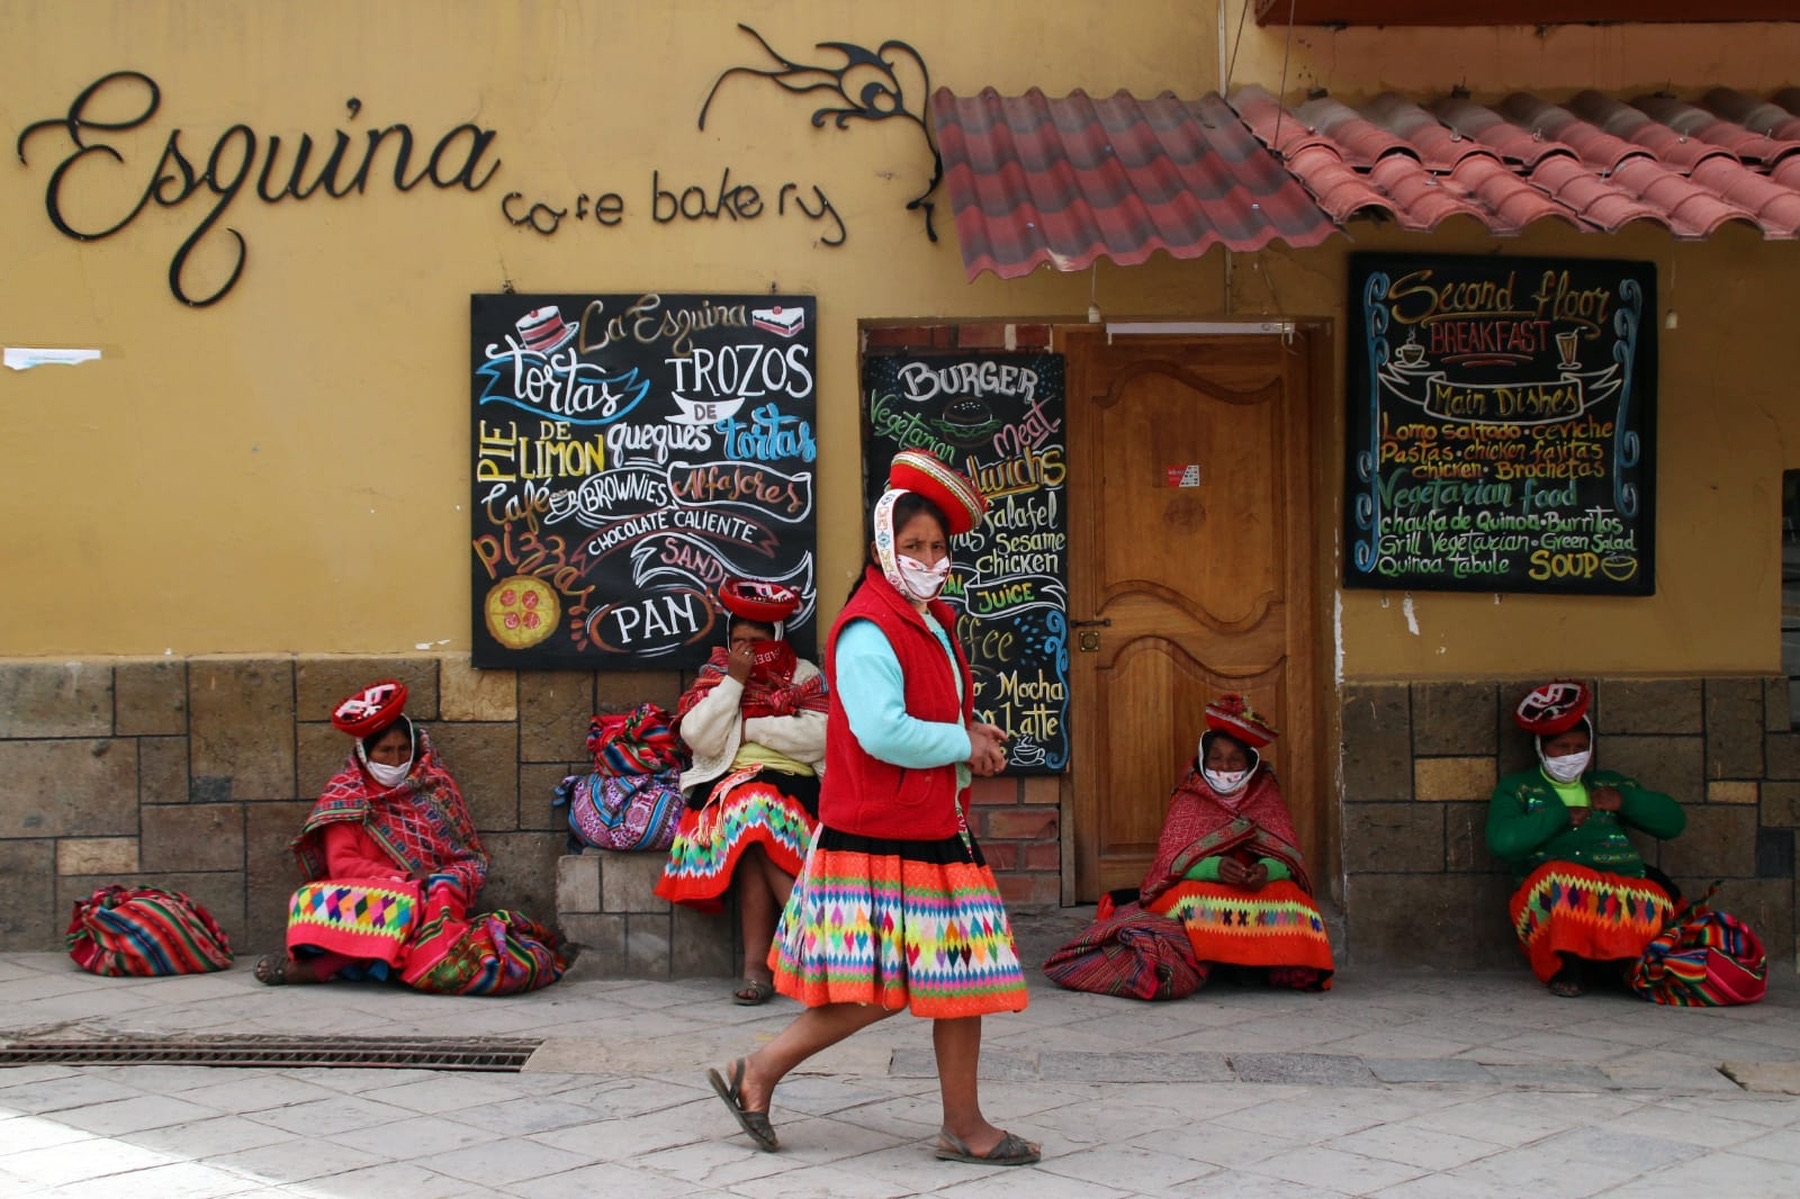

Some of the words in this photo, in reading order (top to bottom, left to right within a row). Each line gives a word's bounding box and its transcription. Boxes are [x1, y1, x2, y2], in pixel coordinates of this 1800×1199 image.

[17, 70, 501, 307] Esquina
[653, 167, 846, 246] bakery
[1388, 269, 1517, 324] Second
[578, 300, 628, 355] La
[625, 293, 748, 358] Esquina
[1429, 321, 1551, 354] BREAKFAST
[665, 344, 813, 398] TROZOS
[694, 404, 717, 420] DE
[1435, 384, 1486, 416] Main
[1492, 384, 1579, 416] Dishes
[540, 421, 571, 440] DE
[607, 422, 711, 468] queques
[1381, 411, 1438, 440] Lomo
[477, 420, 517, 483] PIE
[519, 434, 605, 479] LIMON
[1381, 440, 1454, 463] Pastas
[1495, 459, 1604, 479] Brochetas
[1378, 467, 1512, 516] Vegetarian
[588, 511, 668, 556] CHOCOLATE
[674, 511, 758, 543] CALIENTE
[1451, 506, 1471, 530] de
[1477, 511, 1540, 532] Quinoa
[1544, 505, 1623, 535] Burritos
[1380, 531, 1421, 556] Grill
[1431, 529, 1529, 559] Vegetarian
[1540, 533, 1589, 552] Green
[1591, 529, 1637, 553] Salad
[1378, 556, 1445, 578] Quinoa
[611, 594, 699, 644] PAN
[957, 614, 1014, 666] ffee
[994, 669, 1065, 707] Mocha
[999, 701, 1060, 742] Latte
